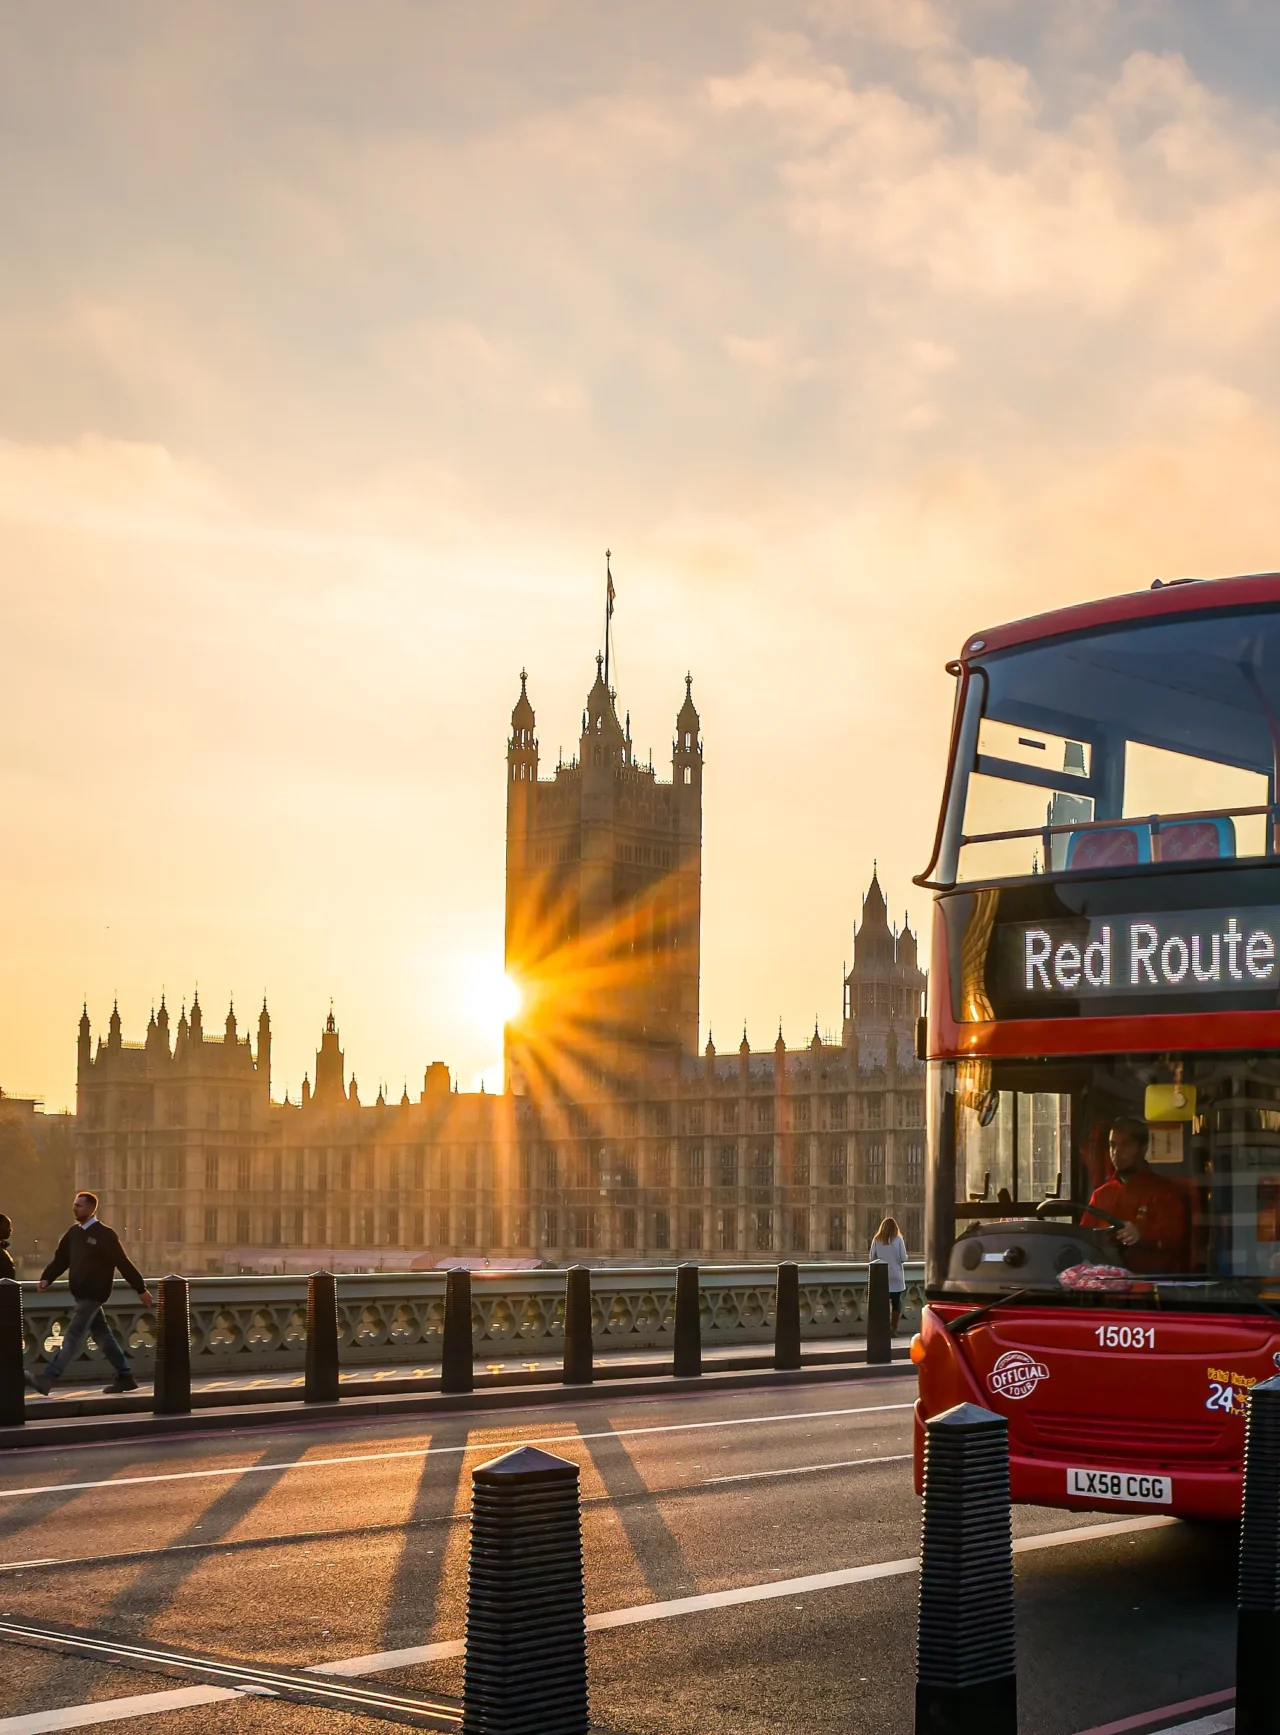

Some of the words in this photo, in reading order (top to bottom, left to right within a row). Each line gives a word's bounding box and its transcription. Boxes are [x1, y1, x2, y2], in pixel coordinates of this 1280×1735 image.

[1025, 926, 1111, 989] Red
[1130, 918, 1275, 983] Route
[1094, 1325, 1155, 1349] 15031
[992, 1366, 1046, 1388] OFFICIAL
[1207, 1367, 1230, 1383] Valid
[1009, 1382, 1034, 1396] TOUR
[1205, 1383, 1234, 1413] 24
[1074, 1471, 1122, 1495] LX58
[1126, 1476, 1164, 1499] CGG
